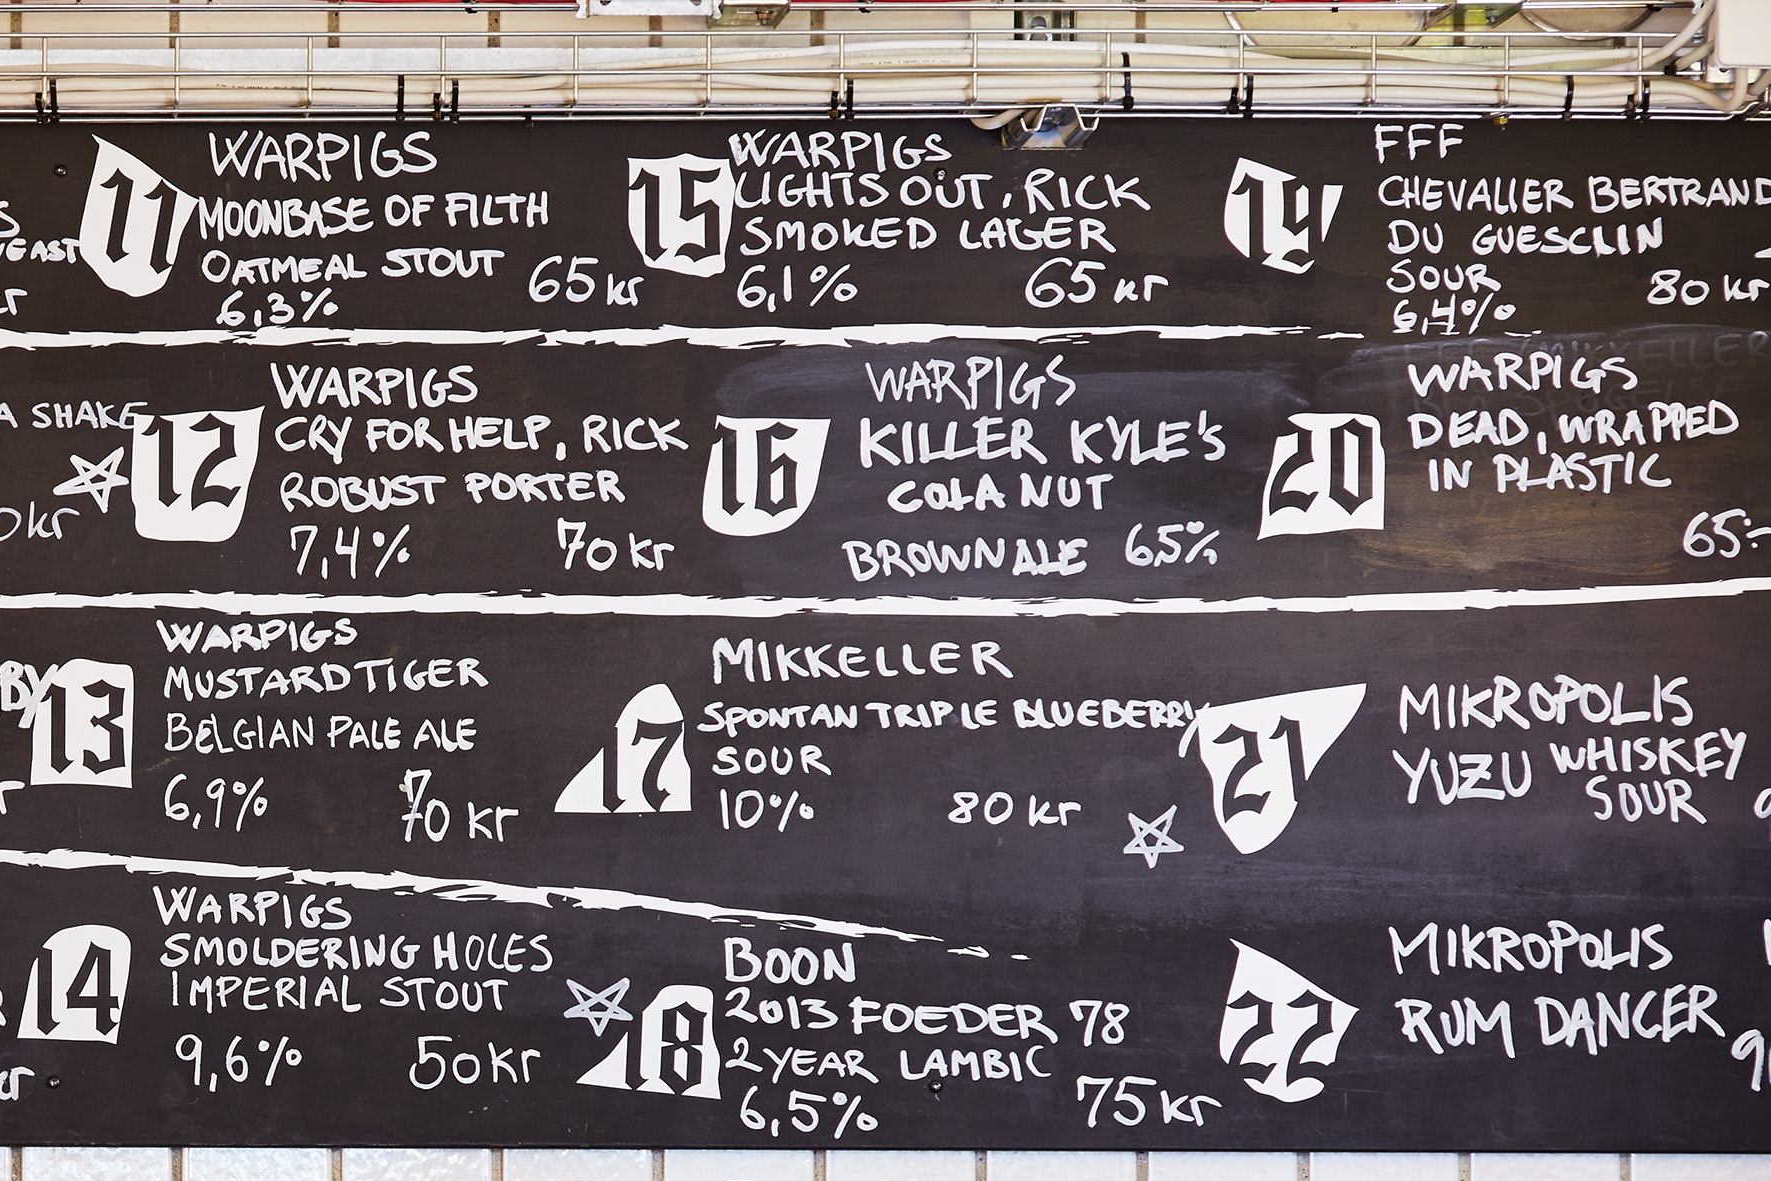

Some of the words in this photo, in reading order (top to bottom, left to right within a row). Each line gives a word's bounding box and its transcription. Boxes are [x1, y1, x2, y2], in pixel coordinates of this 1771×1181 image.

[208, 129, 438, 183] WARPIGS
[727, 128, 953, 173] WARPIGS
[1373, 123, 1464, 165] FFF
[733, 171, 888, 209] LIGHTS
[1023, 167, 1152, 215] RICK
[1377, 174, 1575, 216] CHEVALIER
[198, 197, 374, 242] MOONBASE
[384, 194, 436, 228] OF
[444, 190, 549, 229] FILTH
[739, 216, 938, 256] SMOKED
[959, 216, 1117, 254] LAGER
[1387, 219, 1444, 255] DU
[1471, 216, 1663, 258] GUESCLIN
[201, 249, 368, 287] OATMEAL
[380, 247, 506, 279] STOUT
[1385, 258, 1502, 294] SOUR
[270, 362, 479, 410] WARPIGS
[864, 354, 1077, 411] WARPIGS
[1407, 350, 1639, 398] WARPIGS
[31, 401, 147, 431] SHAKE
[274, 413, 353, 466] CRY
[365, 416, 445, 453] FOR
[582, 414, 690, 454] RICK
[1558, 399, 1740, 447] WRAPPED
[859, 415, 1048, 469] KILLER
[279, 471, 447, 514] ROBUST
[464, 469, 626, 504] PORTER
[886, 472, 1007, 514] COLA
[1019, 472, 1115, 511] NUT
[1428, 457, 1473, 493] IN
[1491, 450, 1673, 495] PLASTIC
[155, 617, 358, 655] WARPIGS
[711, 636, 1014, 685] MIKKELLER
[1399, 672, 1694, 735] MIKROPOLIS
[164, 712, 314, 755] BELGIAN
[326, 715, 402, 751] PALE
[413, 718, 477, 753] ALE
[696, 701, 858, 738] SPONTAN
[864, 699, 998, 730] TRIPLE
[1014, 700, 1211, 759] BLUEBERRY
[711, 744, 832, 776] SOUR
[1391, 746, 1533, 806] YUZU
[1548, 727, 1748, 781] WHISKEY
[1584, 774, 1708, 825] SOUR
[152, 885, 353, 931] WARPIGS
[159, 932, 421, 971] SMOLDERING
[432, 931, 553, 973] HOLES
[723, 936, 857, 986] BOON
[1387, 919, 1674, 976] MIKROPOLIS
[171, 970, 362, 1015] IMPERIAL
[379, 975, 509, 1013] STOUT
[724, 986, 839, 1030] 2013
[847, 995, 1059, 1045] FOEDER
[1394, 996, 1516, 1059] RUM
[1533, 983, 1726, 1056] DANCER
[899, 1044, 1052, 1083] LAMBIC
